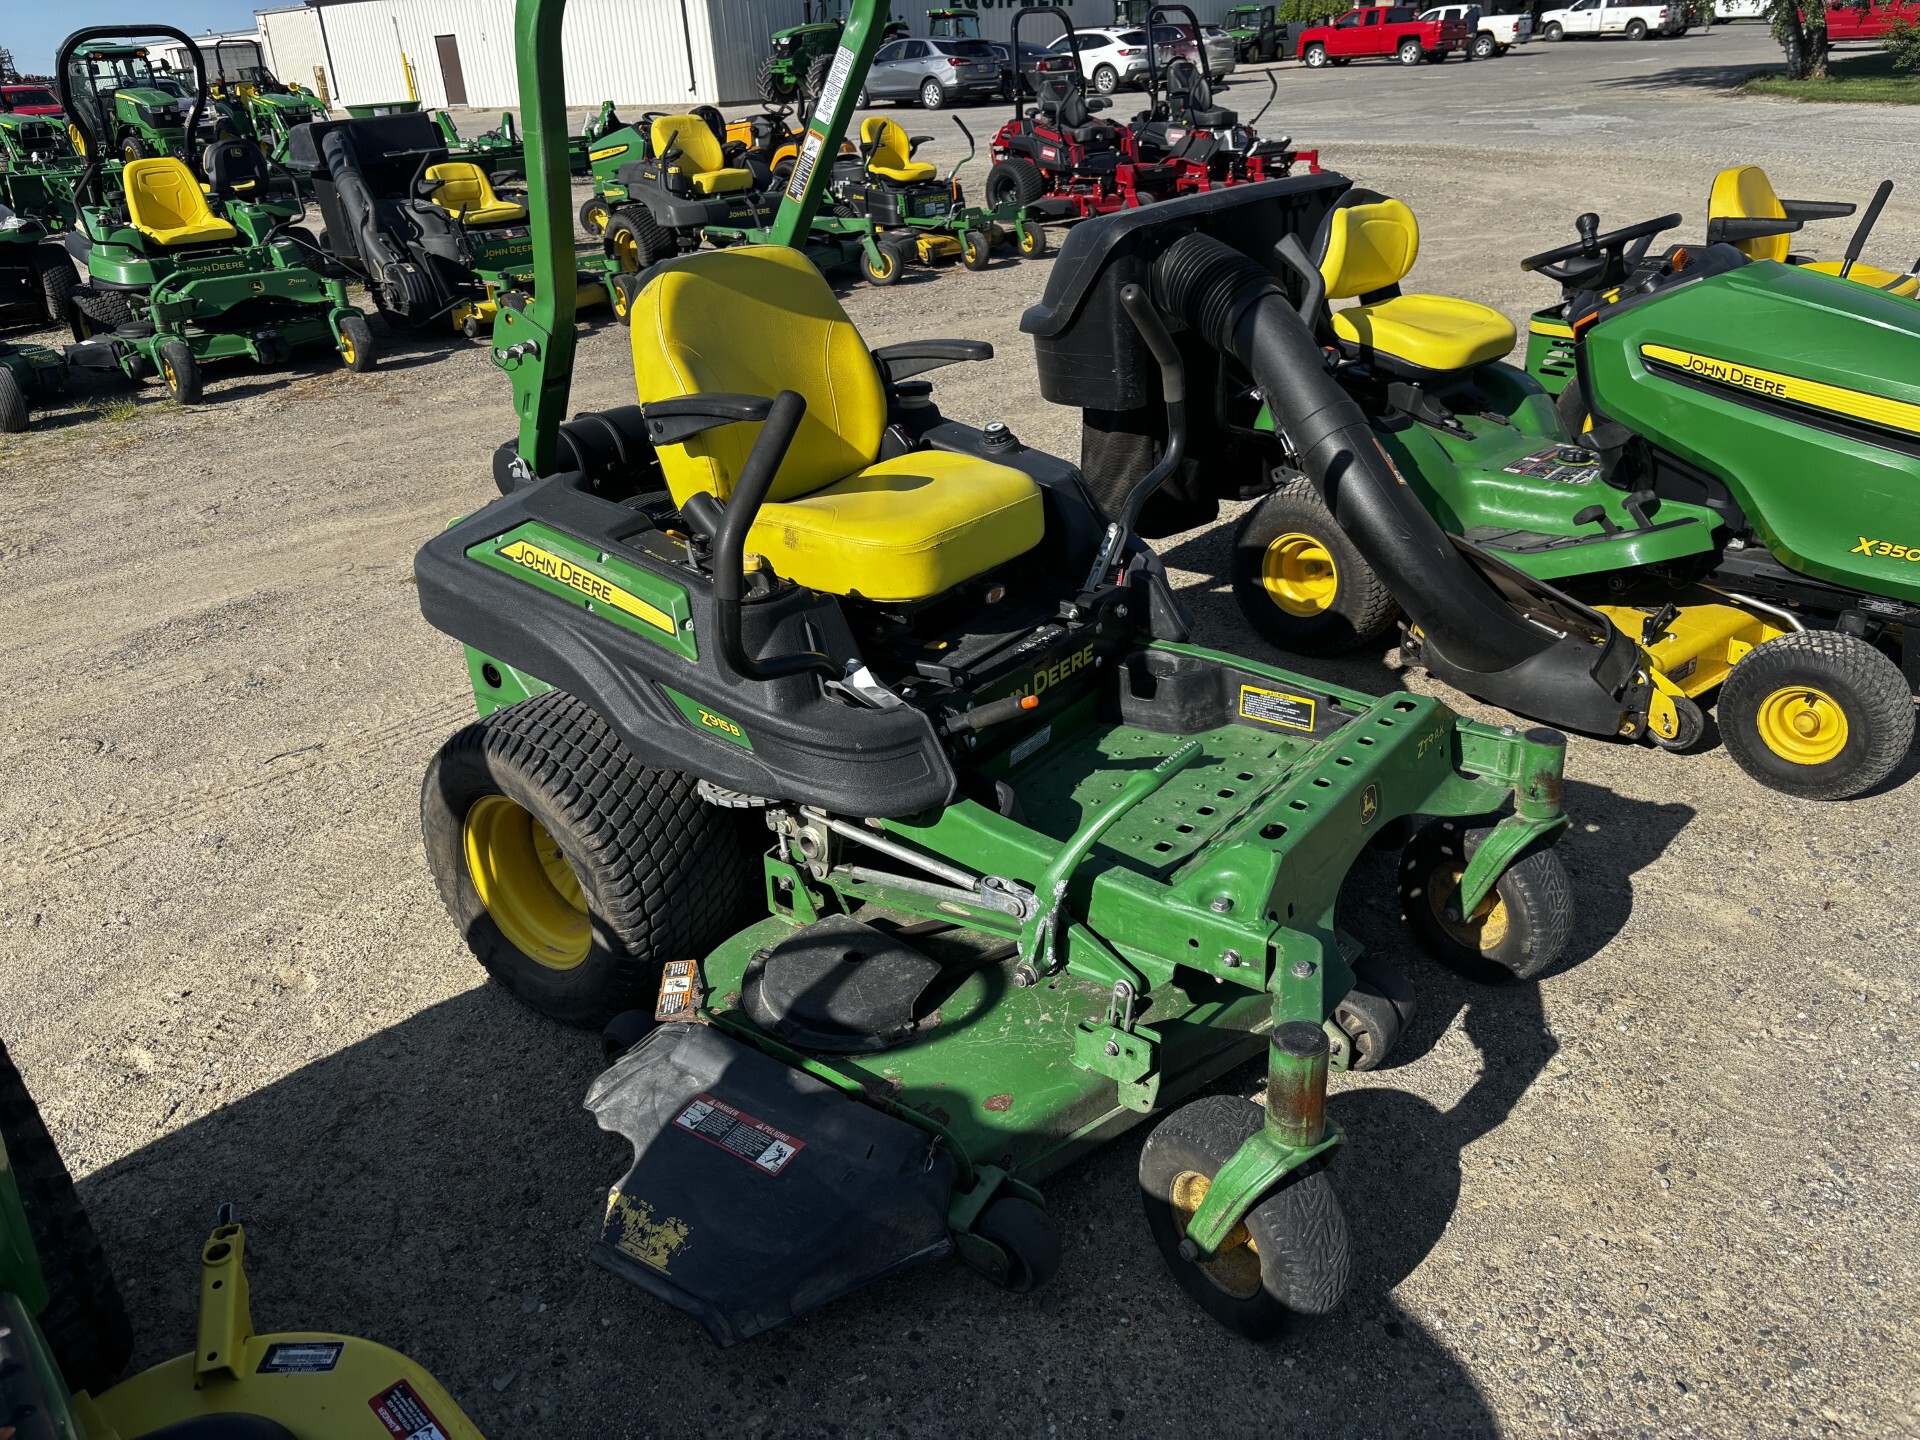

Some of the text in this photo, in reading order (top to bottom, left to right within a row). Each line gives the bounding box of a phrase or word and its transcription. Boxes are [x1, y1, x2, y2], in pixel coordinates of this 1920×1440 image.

[728, 208, 771, 218] JOHN DERE
[484, 244, 534, 257] JOHN DEER
[211, 261, 245, 271] DEERE
[1683, 355, 1786, 396] JOHN DEERE
[1850, 536, 1920, 562] X350
[515, 545, 612, 601] JOHN DEERE
[1033, 643, 1094, 695] DEERE
[698, 708, 741, 737] Z915B
[714, 1101, 740, 1117] DANGER
[762, 1125, 790, 1142] PELIGRO
[378, 1407, 396, 1428] DANGER
